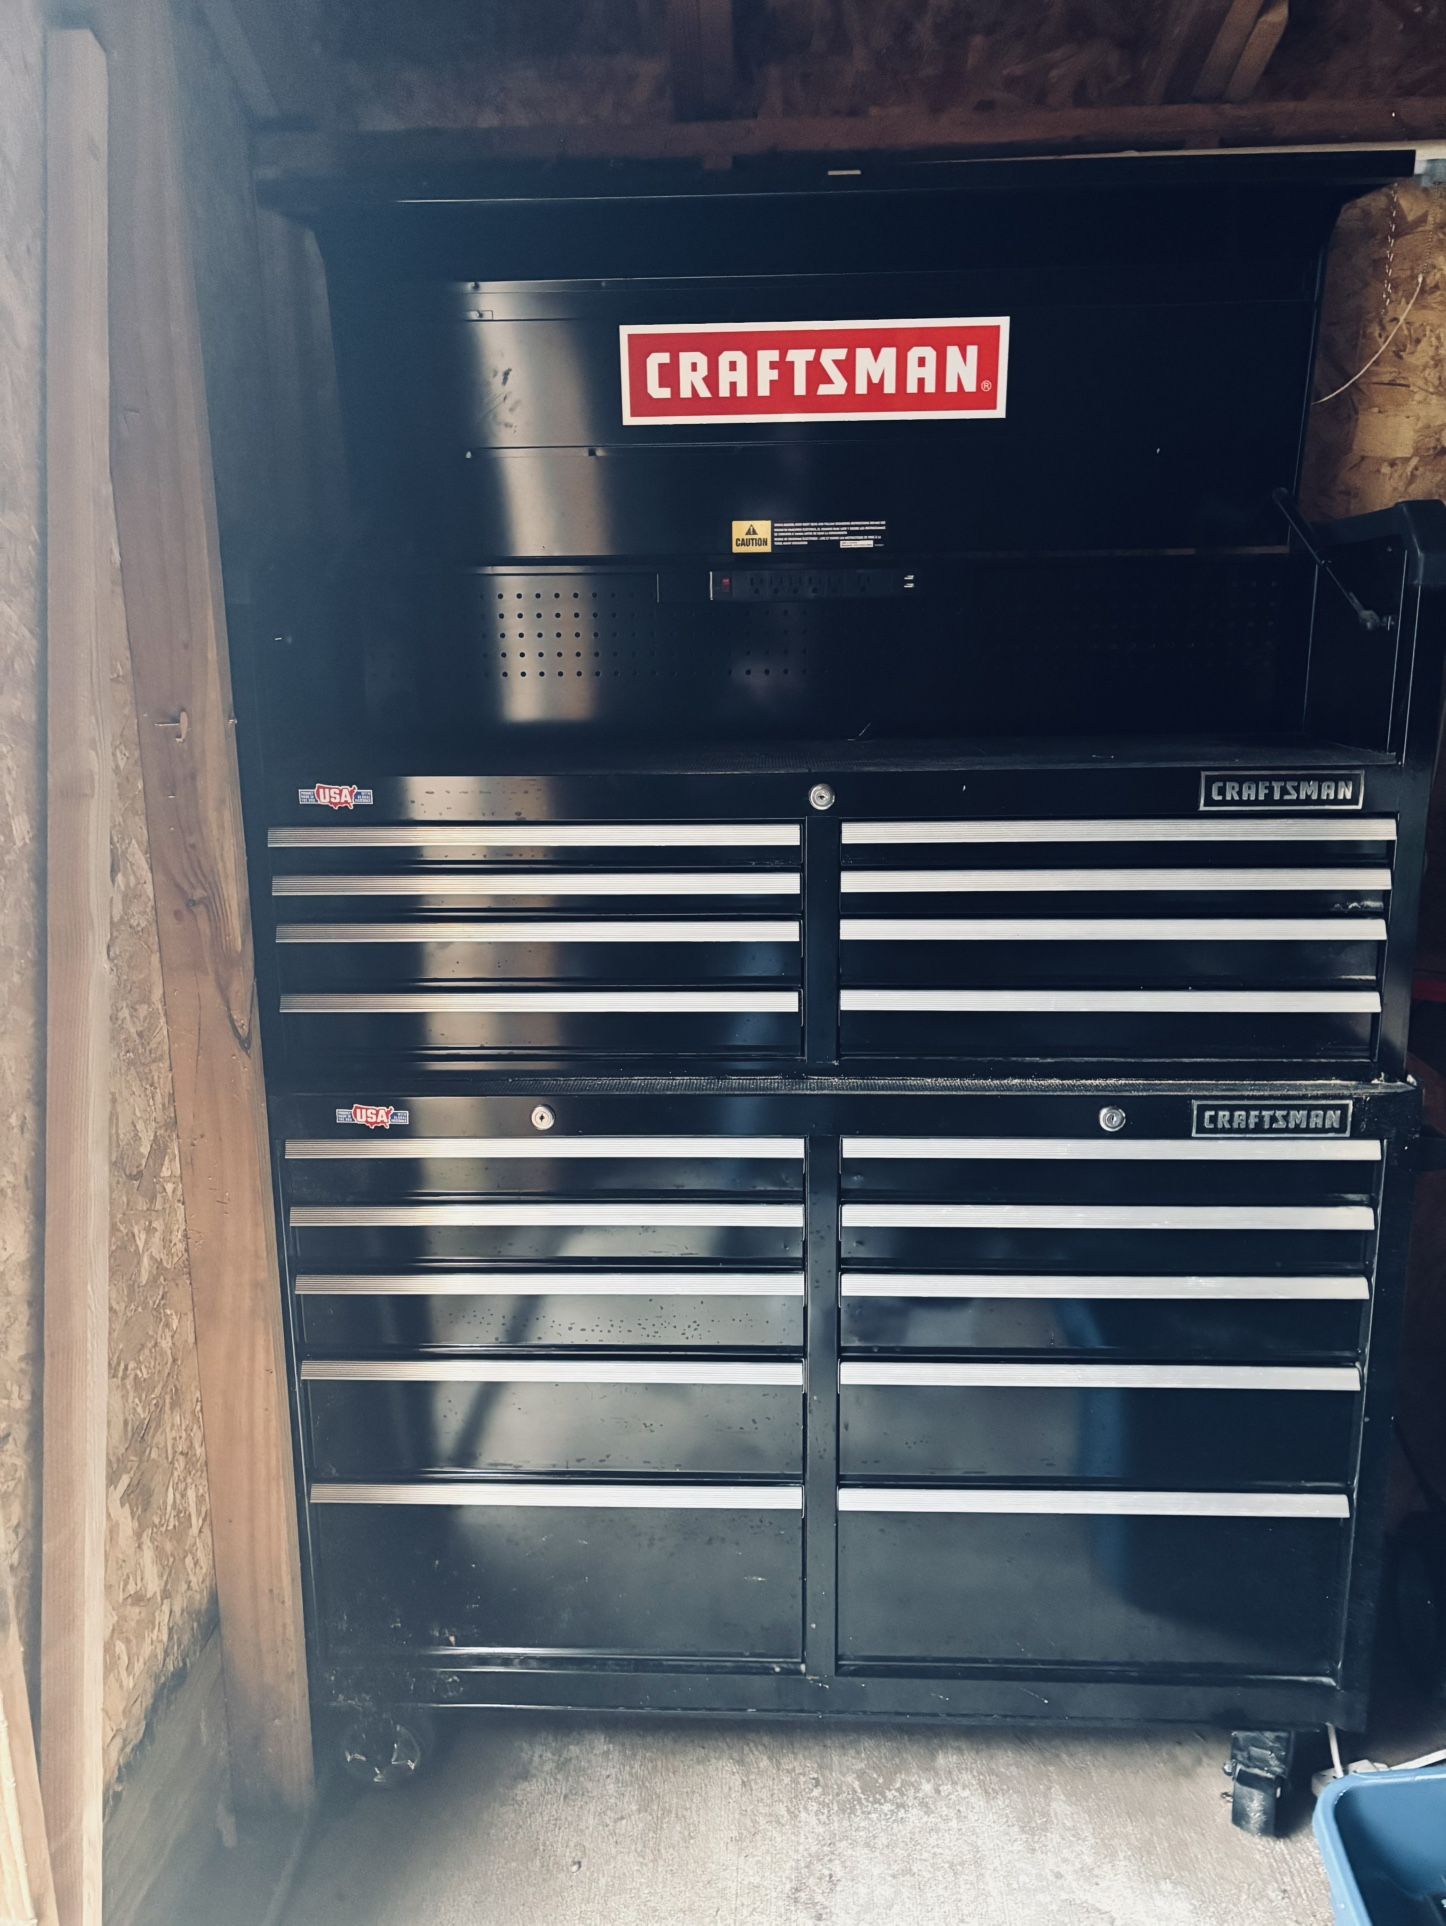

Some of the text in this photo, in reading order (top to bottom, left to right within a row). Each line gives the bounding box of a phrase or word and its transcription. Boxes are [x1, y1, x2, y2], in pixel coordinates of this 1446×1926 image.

[735, 537, 768, 547] CAUTION
[319, 788, 352, 803] USA
[1211, 780, 1353, 801] CRAFTSMAN
[356, 1108, 388, 1123] USA
[1204, 1110, 1341, 1129] CRAFTSMAN
